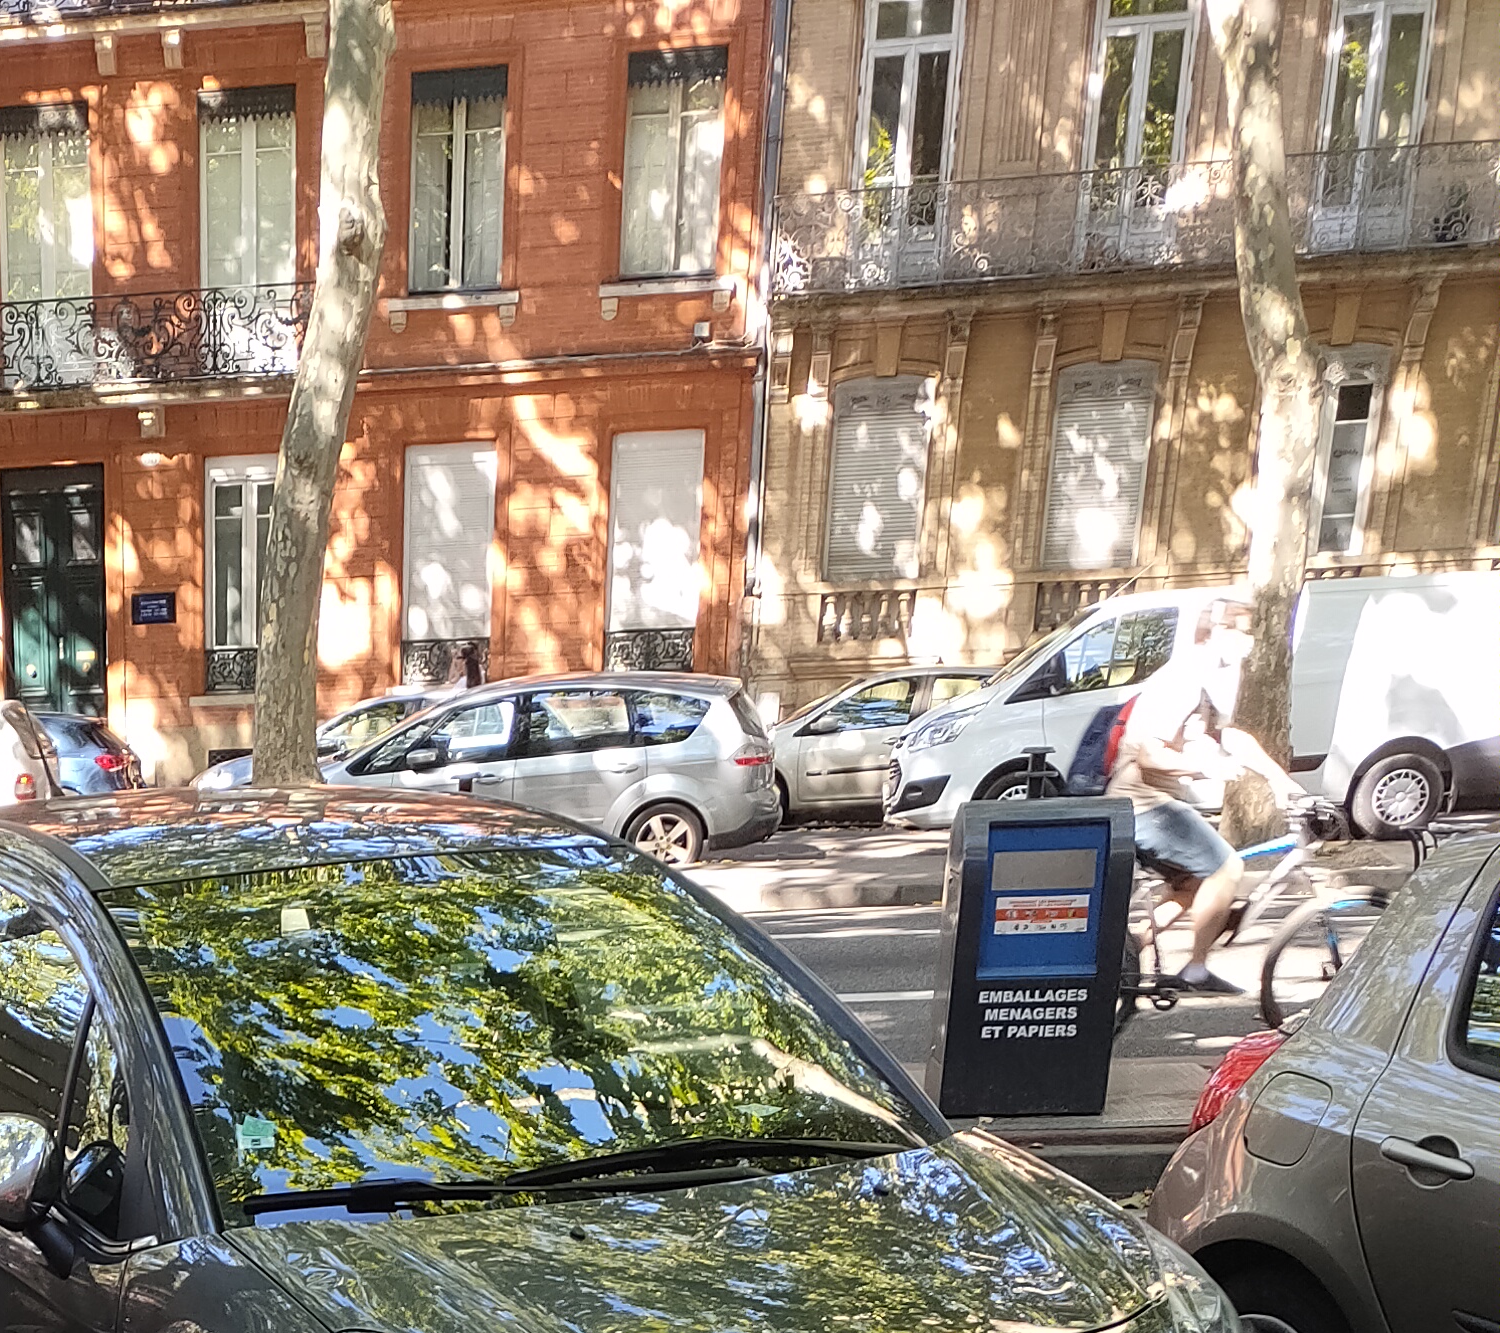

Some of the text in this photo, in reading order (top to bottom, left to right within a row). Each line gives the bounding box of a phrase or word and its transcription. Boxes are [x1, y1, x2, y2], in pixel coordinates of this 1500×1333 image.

[978, 989, 1088, 1004] EMBALLAGES
[984, 1007, 1078, 1021] MENAGERS
[981, 1024, 1078, 1039] ET PAPIERS
